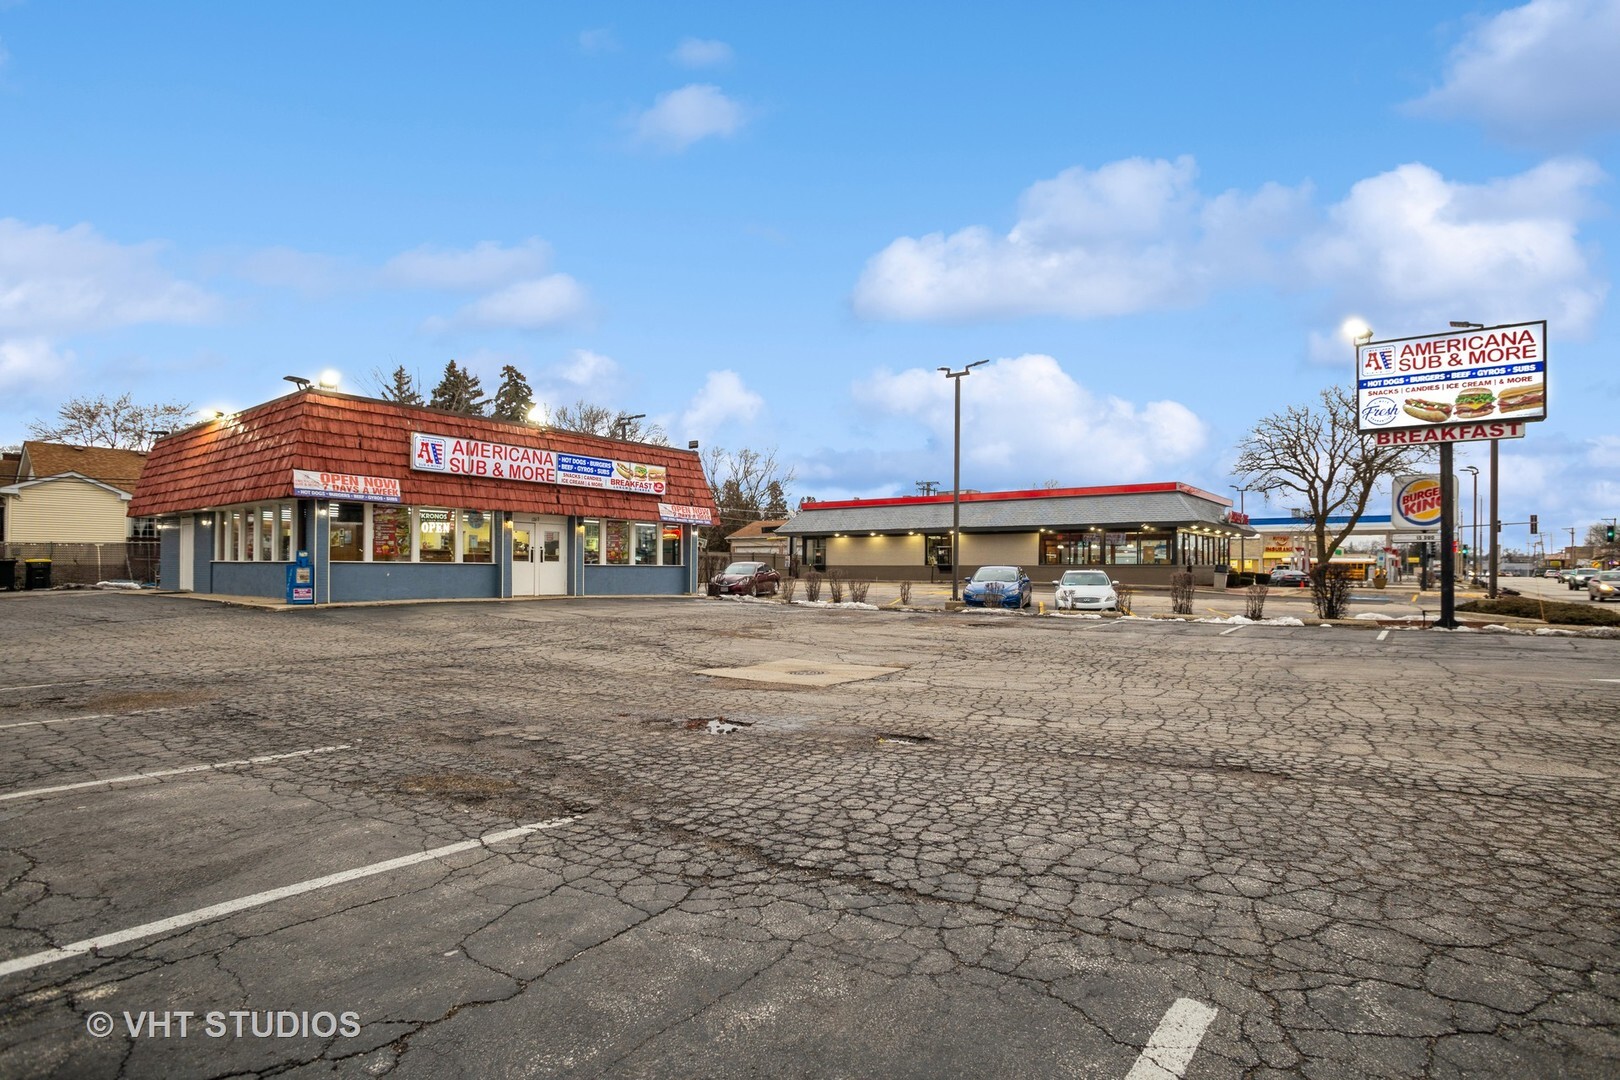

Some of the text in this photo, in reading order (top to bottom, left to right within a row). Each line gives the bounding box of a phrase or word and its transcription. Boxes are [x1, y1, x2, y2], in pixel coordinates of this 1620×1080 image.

[1400, 330, 1534, 358] AMERICANA
[1399, 344, 1536, 372] SUB & MORE
[1383, 378, 1404, 386] DOGS
[1410, 374, 1444, 382] BURGERS
[1477, 368, 1506, 376] GYROS
[1513, 365, 1536, 373] SUBS
[1368, 388, 1399, 396] SNACKS
[1462, 379, 1491, 388] CREAM
[1362, 403, 1400, 420] Fresh
[1377, 423, 1522, 445] BREAKFAST
[452, 440, 554, 466] AMERICANA
[449, 458, 555, 482] SUB & MORE
[320, 473, 359, 486] OPEN
[364, 477, 396, 488] NOW
[332, 485, 358, 493] DAYS
[611, 478, 652, 489] BREAKFAST
[1402, 487, 1440, 505] BURGE
[672, 505, 690, 513] OPEN
[421, 522, 450, 533] OPEN
